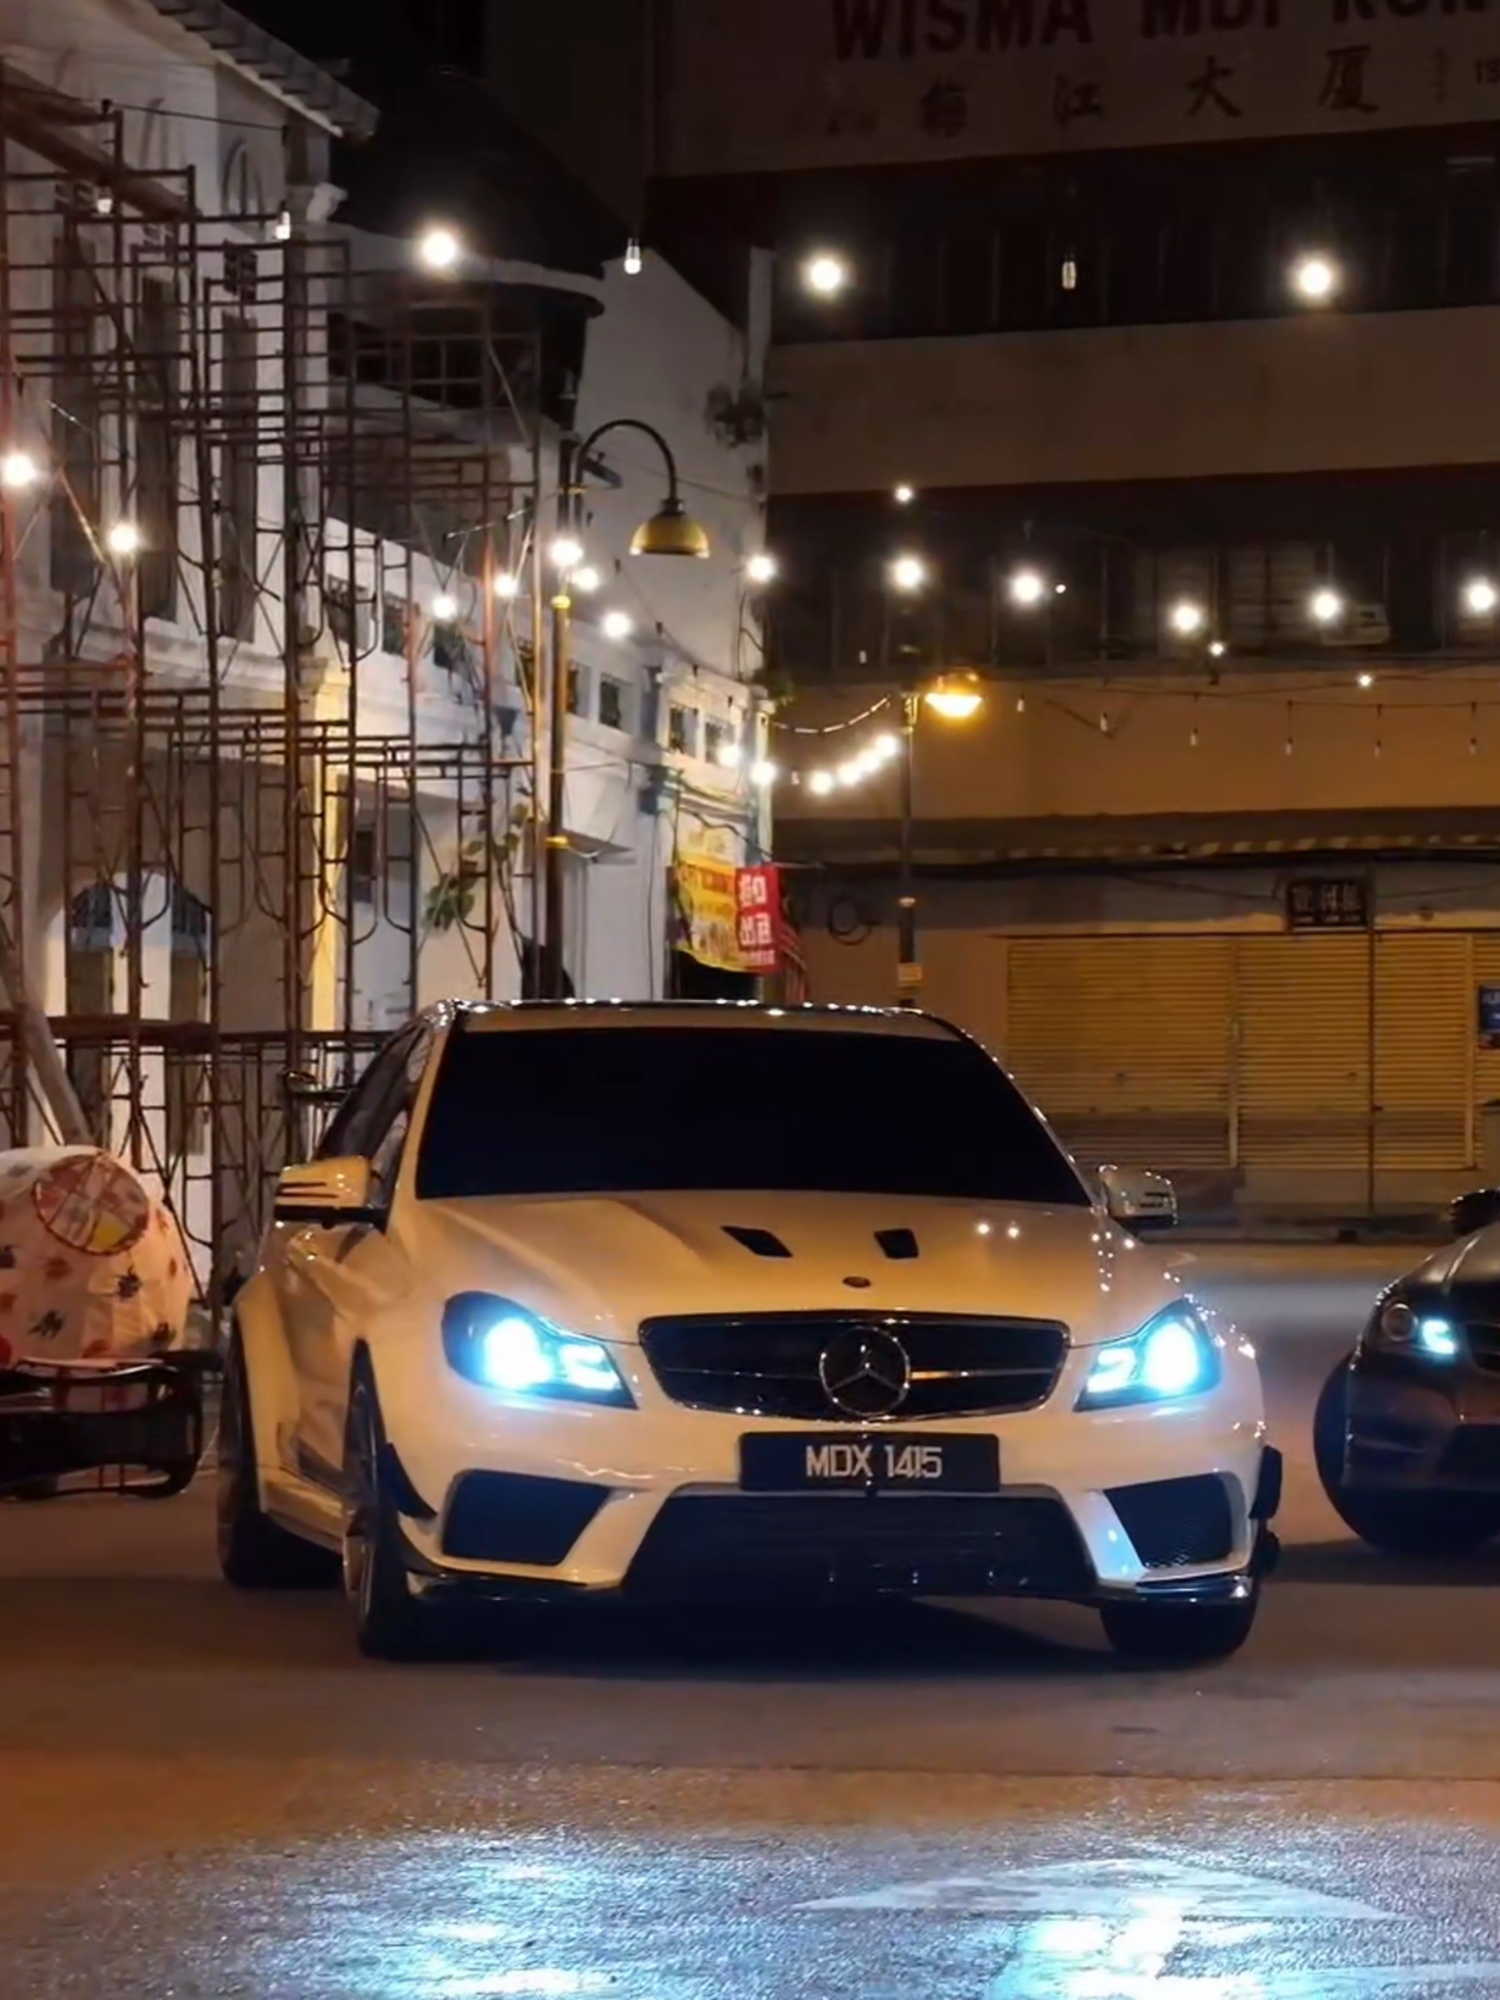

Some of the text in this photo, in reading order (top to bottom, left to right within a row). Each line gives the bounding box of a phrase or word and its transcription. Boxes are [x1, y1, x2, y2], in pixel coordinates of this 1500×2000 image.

[832, 0, 1094, 61] WISMA
[805, 1444, 943, 1479] MDX 1415
